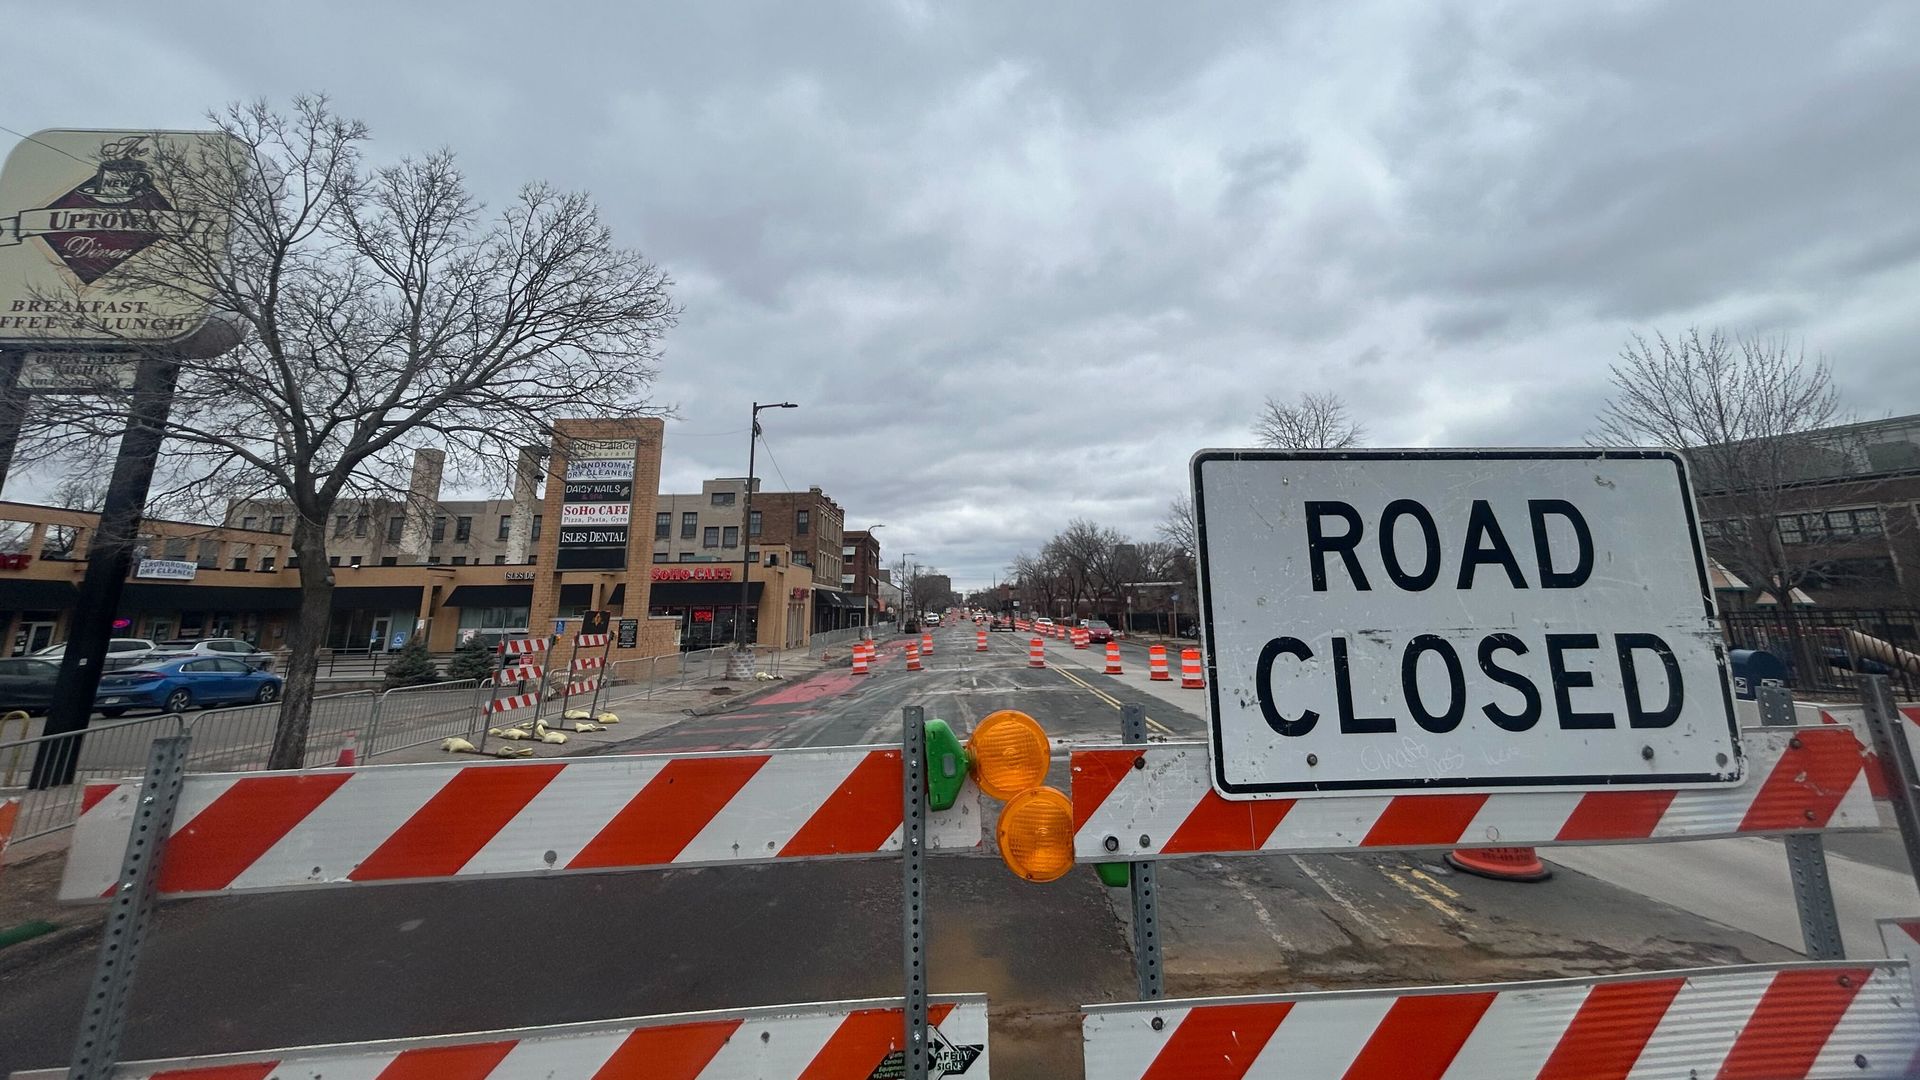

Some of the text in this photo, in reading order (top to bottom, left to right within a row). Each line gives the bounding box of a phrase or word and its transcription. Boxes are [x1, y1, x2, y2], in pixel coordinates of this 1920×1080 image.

[63, 236, 132, 259] Diner
[10, 300, 148, 313] BREAKFAST
[0, 316, 185, 330] FFEE & LUNCH
[600, 441, 634, 450] Palace
[571, 461, 631, 470] LAUNDROMAT
[587, 470, 632, 478] CLEANERS
[566, 484, 620, 493] DAISY NAILS
[564, 505, 628, 515] SoHo CAFE
[561, 531, 625, 543] ISLES DENTAL
[1304, 499, 1594, 592] ROAD
[694, 567, 732, 580] CAFE
[1256, 633, 1684, 737] CLOSED
[937, 1062, 963, 1071] SIGNS
